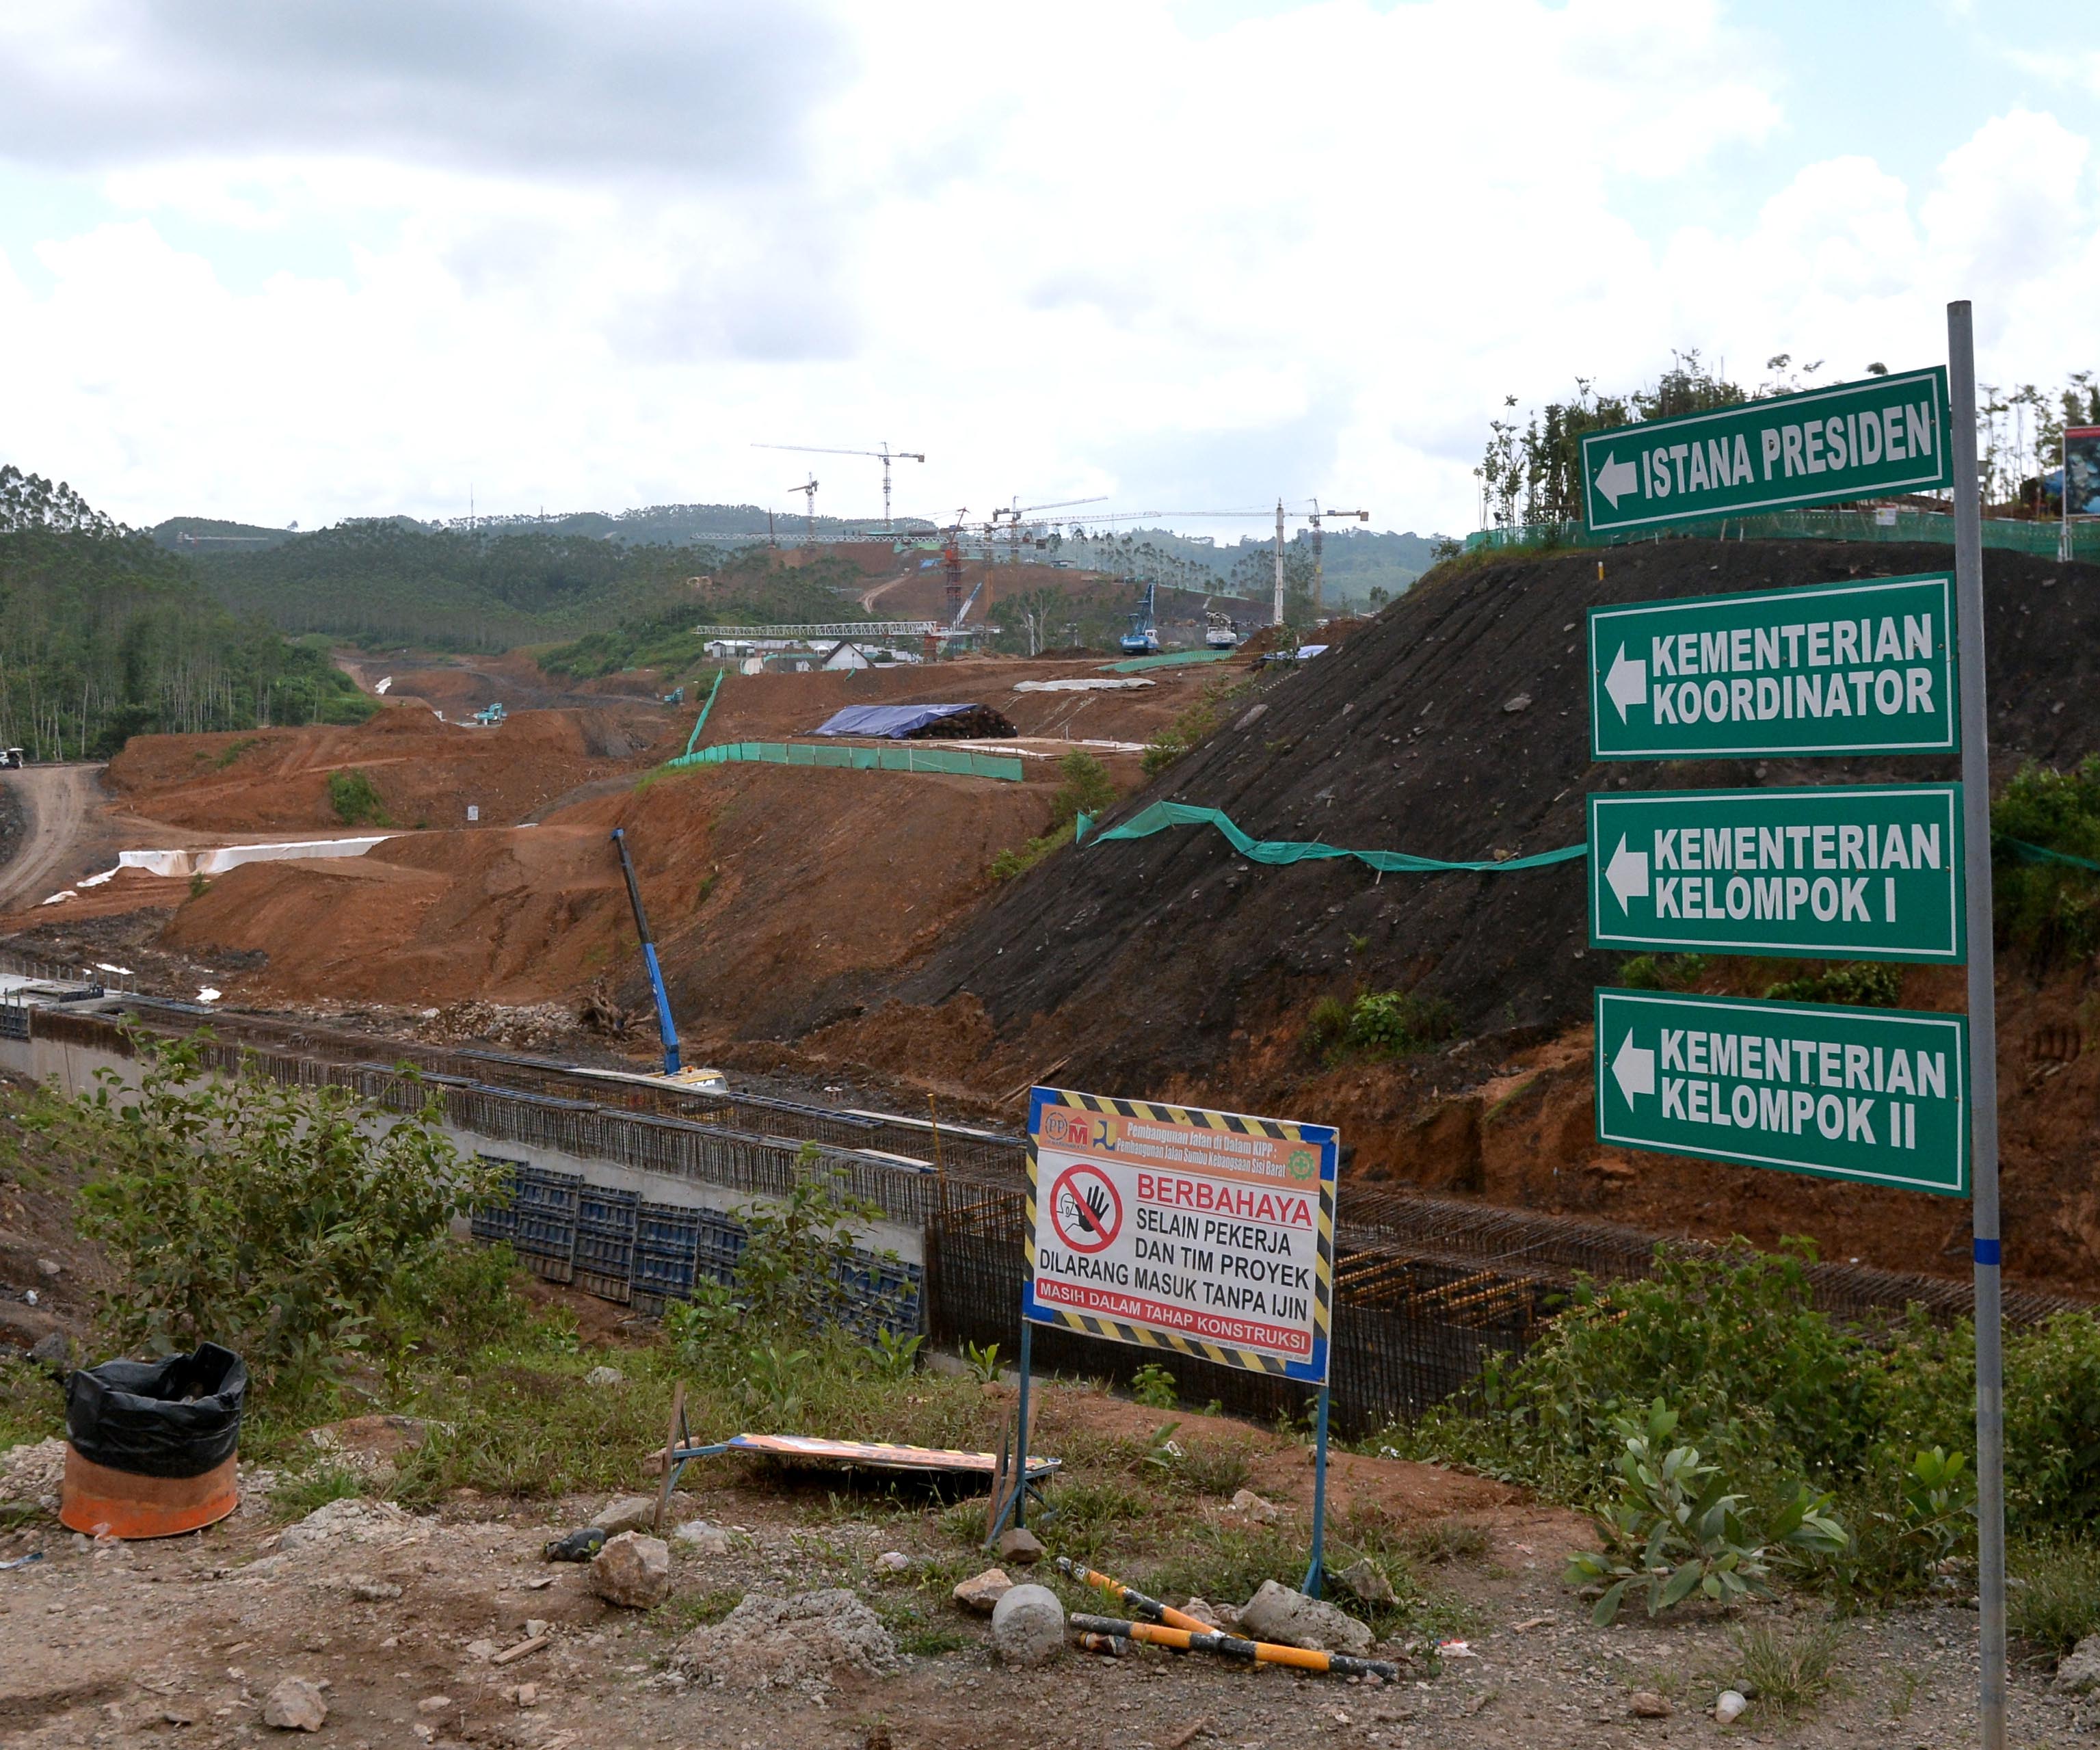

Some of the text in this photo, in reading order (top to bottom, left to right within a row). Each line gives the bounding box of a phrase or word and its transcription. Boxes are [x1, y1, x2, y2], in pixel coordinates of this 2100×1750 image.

[1642, 401, 1932, 499] ISTANA PRESIDEN
[1651, 613, 1932, 677] KEMENTERIAN
[1653, 667, 1935, 725] KOORDINATOR
[1654, 823, 1941, 871] KEMENTERIAN
[1656, 876, 1896, 923] KELOMPOK I
[1660, 1029, 1947, 1099] KEMENTERIAN
[1127, 1122, 1188, 1145] Pembangunan
[1190, 1132, 1212, 1148] Jalan
[1213, 1135, 1222, 1150] di
[1224, 1137, 1251, 1155] Dalam
[1662, 1077, 1915, 1149] KELOMPOK II
[1117, 1138, 1286, 1178] Pembangunan Jalan Sumbu Kebangsaan Sisi Barat
[1138, 1174, 1312, 1226] BERBAHAYA
[1137, 1208, 1291, 1256] SELAIN PEKERJA
[1040, 1249, 1307, 1321] DILARANG MASUK TANPA IJIN
[1135, 1237, 1310, 1290] DAN TIM PROYEK
[1040, 1283, 1305, 1350] MASIH DALAM TAHAP KONSTRUKSI
